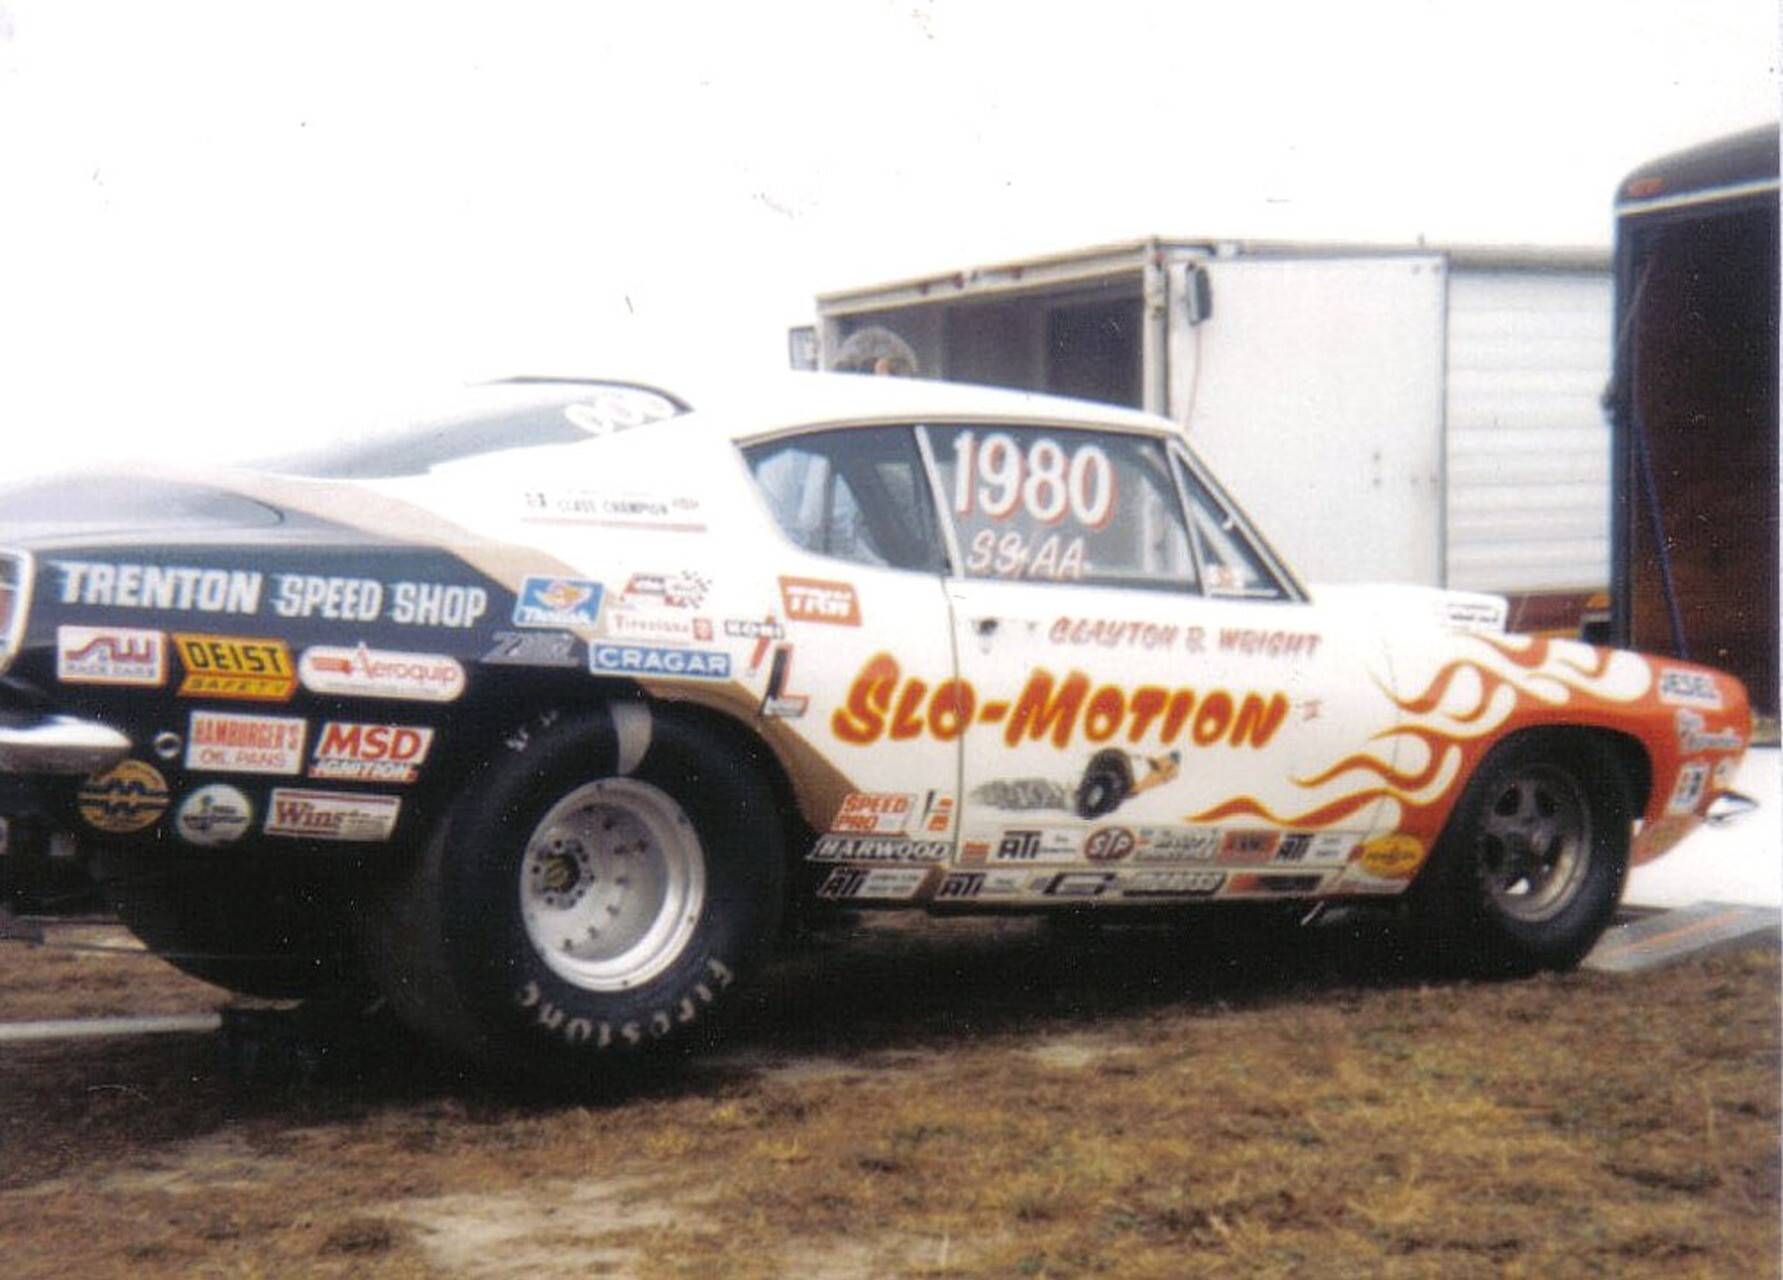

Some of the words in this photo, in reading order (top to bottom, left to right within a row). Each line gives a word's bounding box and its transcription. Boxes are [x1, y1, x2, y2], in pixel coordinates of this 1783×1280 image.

[954, 430, 1119, 530] 1980
[57, 562, 262, 614] TRENTON
[274, 574, 383, 622] SPEED
[391, 583, 487, 628] SHOP
[1049, 616, 1180, 650] CLAYTON
[185, 641, 283, 673] DEIST
[356, 646, 456, 686] Aeroquip
[598, 647, 727, 675] CRAGAR
[831, 651, 1290, 750] SLO-MOTION
[193, 718, 300, 751] HAMBURGER'S
[319, 722, 422, 762] MSD
[812, 838, 950, 863] HARWOOD
